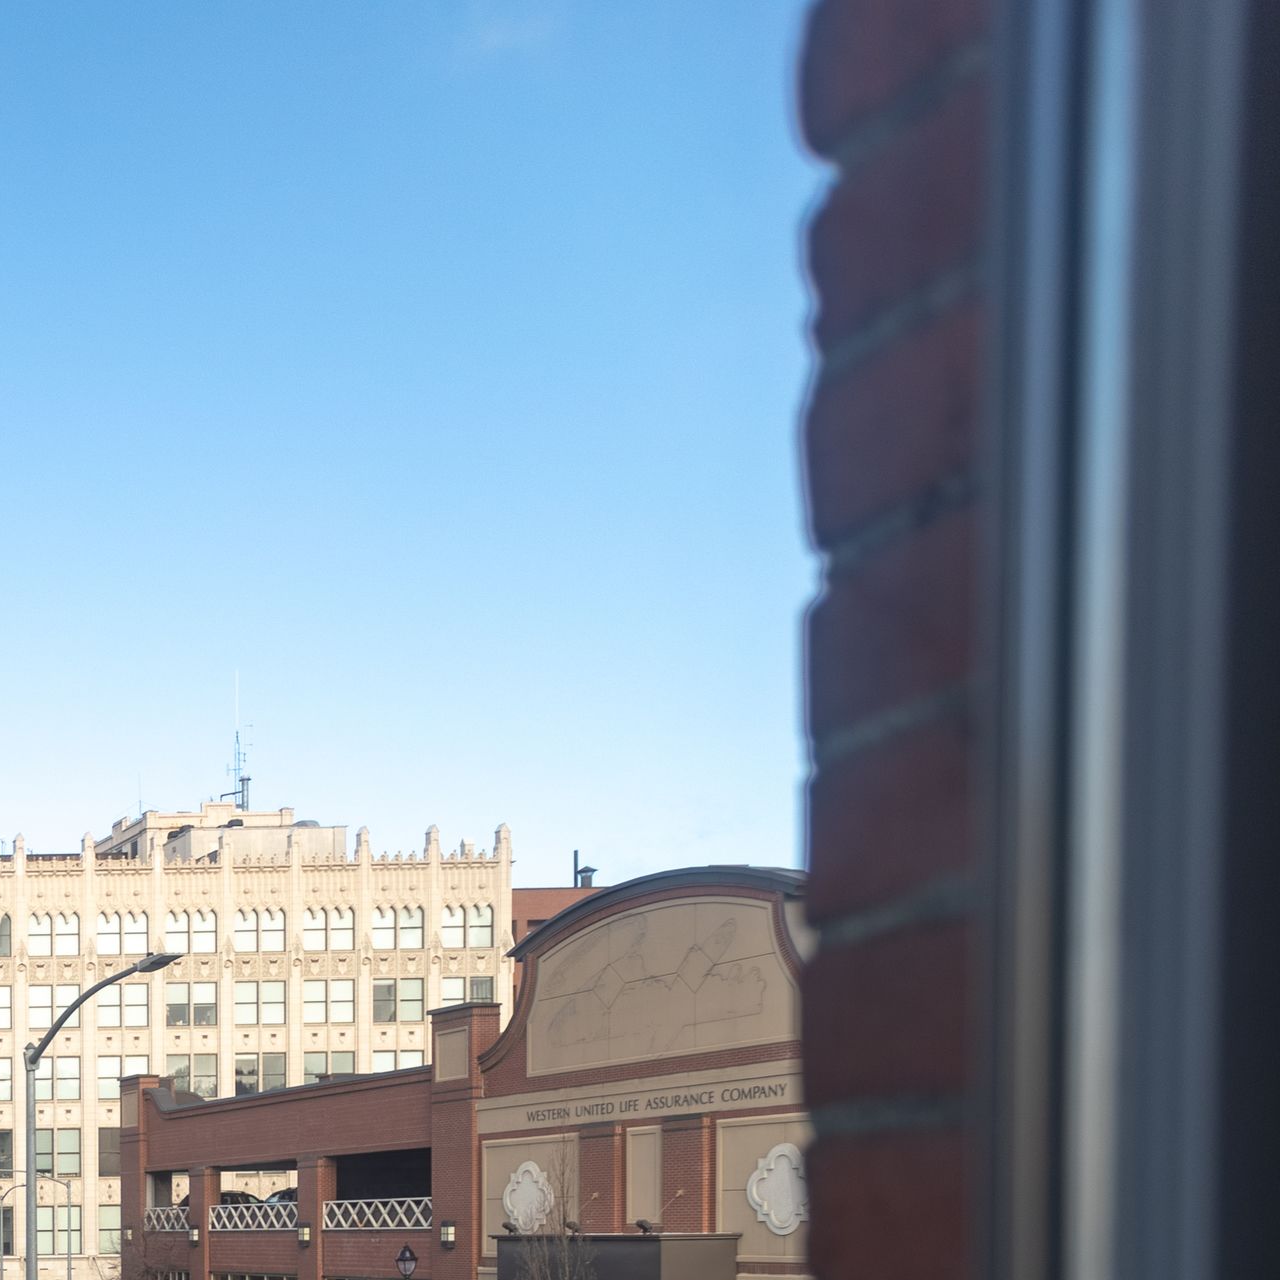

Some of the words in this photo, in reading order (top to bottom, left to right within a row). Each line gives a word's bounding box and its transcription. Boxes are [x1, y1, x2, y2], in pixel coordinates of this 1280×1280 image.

[526, 1107, 571, 1123] WESTERN
[575, 1102, 615, 1117] UNITED
[619, 1099, 640, 1113] LIFE
[644, 1091, 715, 1111] ASSURANCE
[721, 1083, 788, 1103] COMPANY
